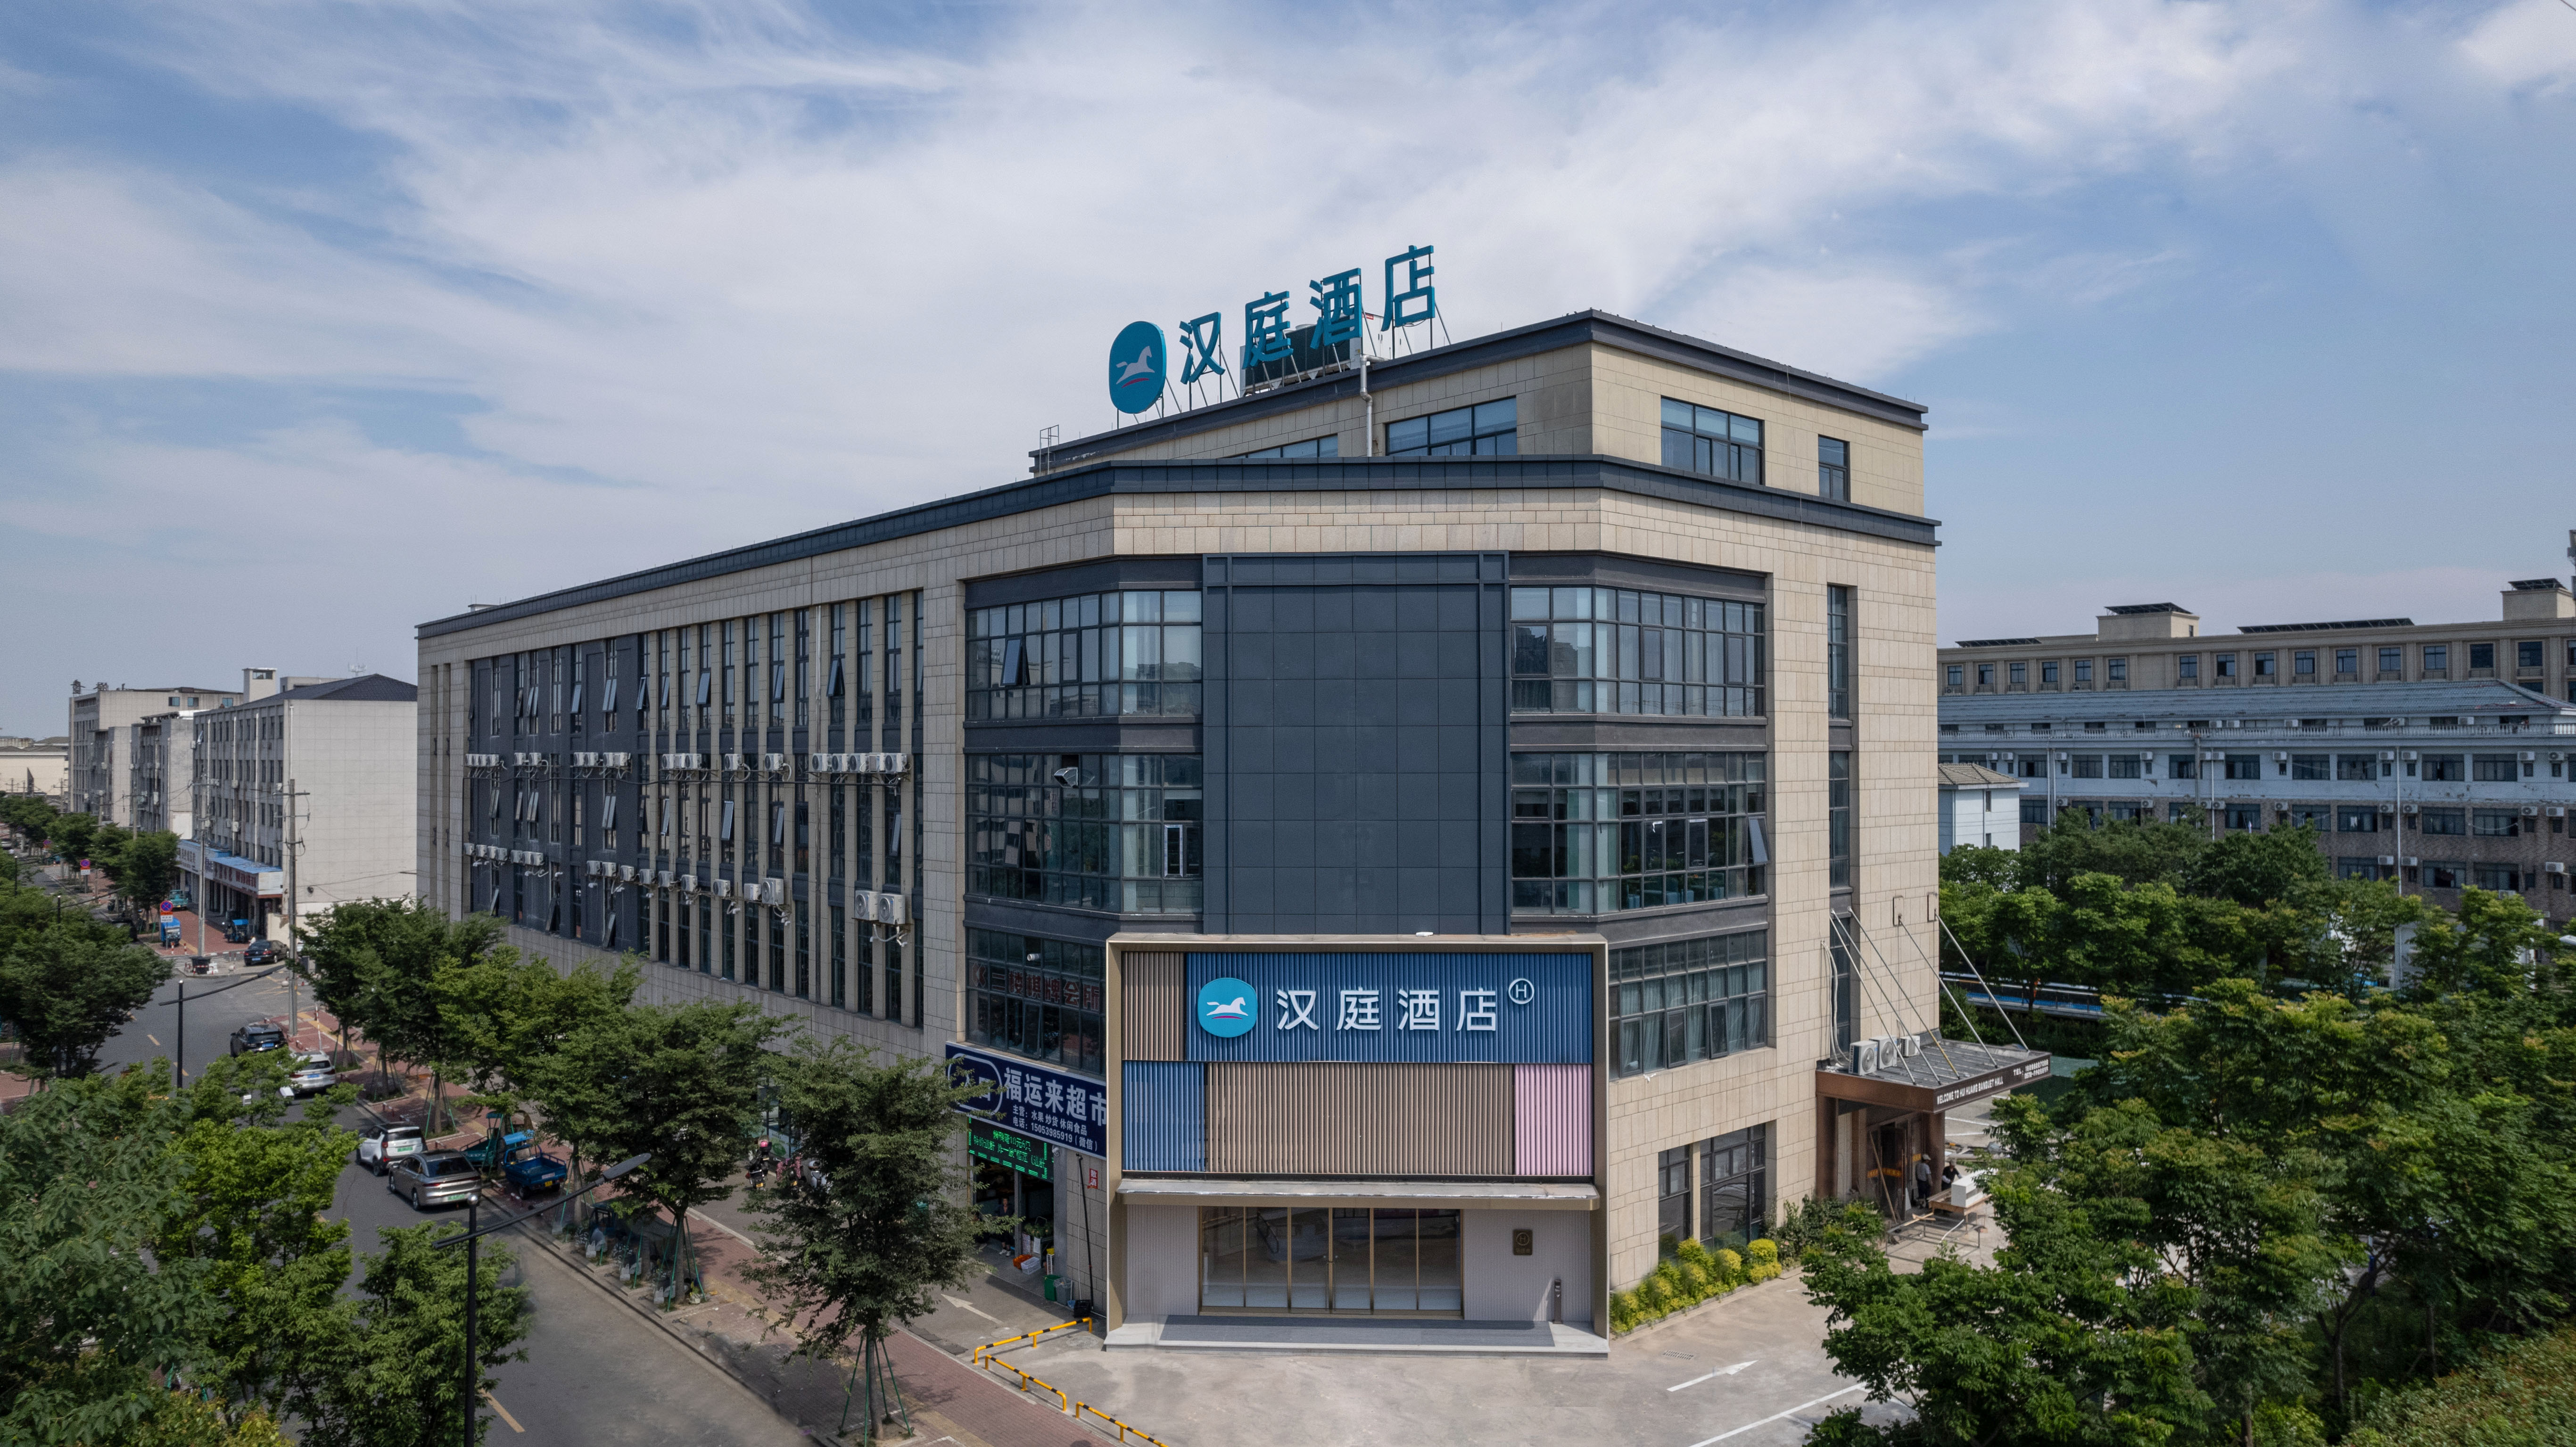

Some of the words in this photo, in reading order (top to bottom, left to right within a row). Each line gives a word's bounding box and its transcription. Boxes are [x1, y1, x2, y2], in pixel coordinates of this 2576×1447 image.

[1179, 245, 1435, 385] 汉庭酒店
[1277, 987, 1496, 1031] 汉庭酒店
[1004, 1067, 1106, 1126] 福运来超市
[1937, 1091, 1954, 1105] WELCOME
[1954, 1089, 1959, 1099] TO
[1994, 1076, 2004, 1086] HALL
[1031, 1123, 1073, 1143] 15053985919
[1060, 1118, 1087, 1136] 休闲食品
